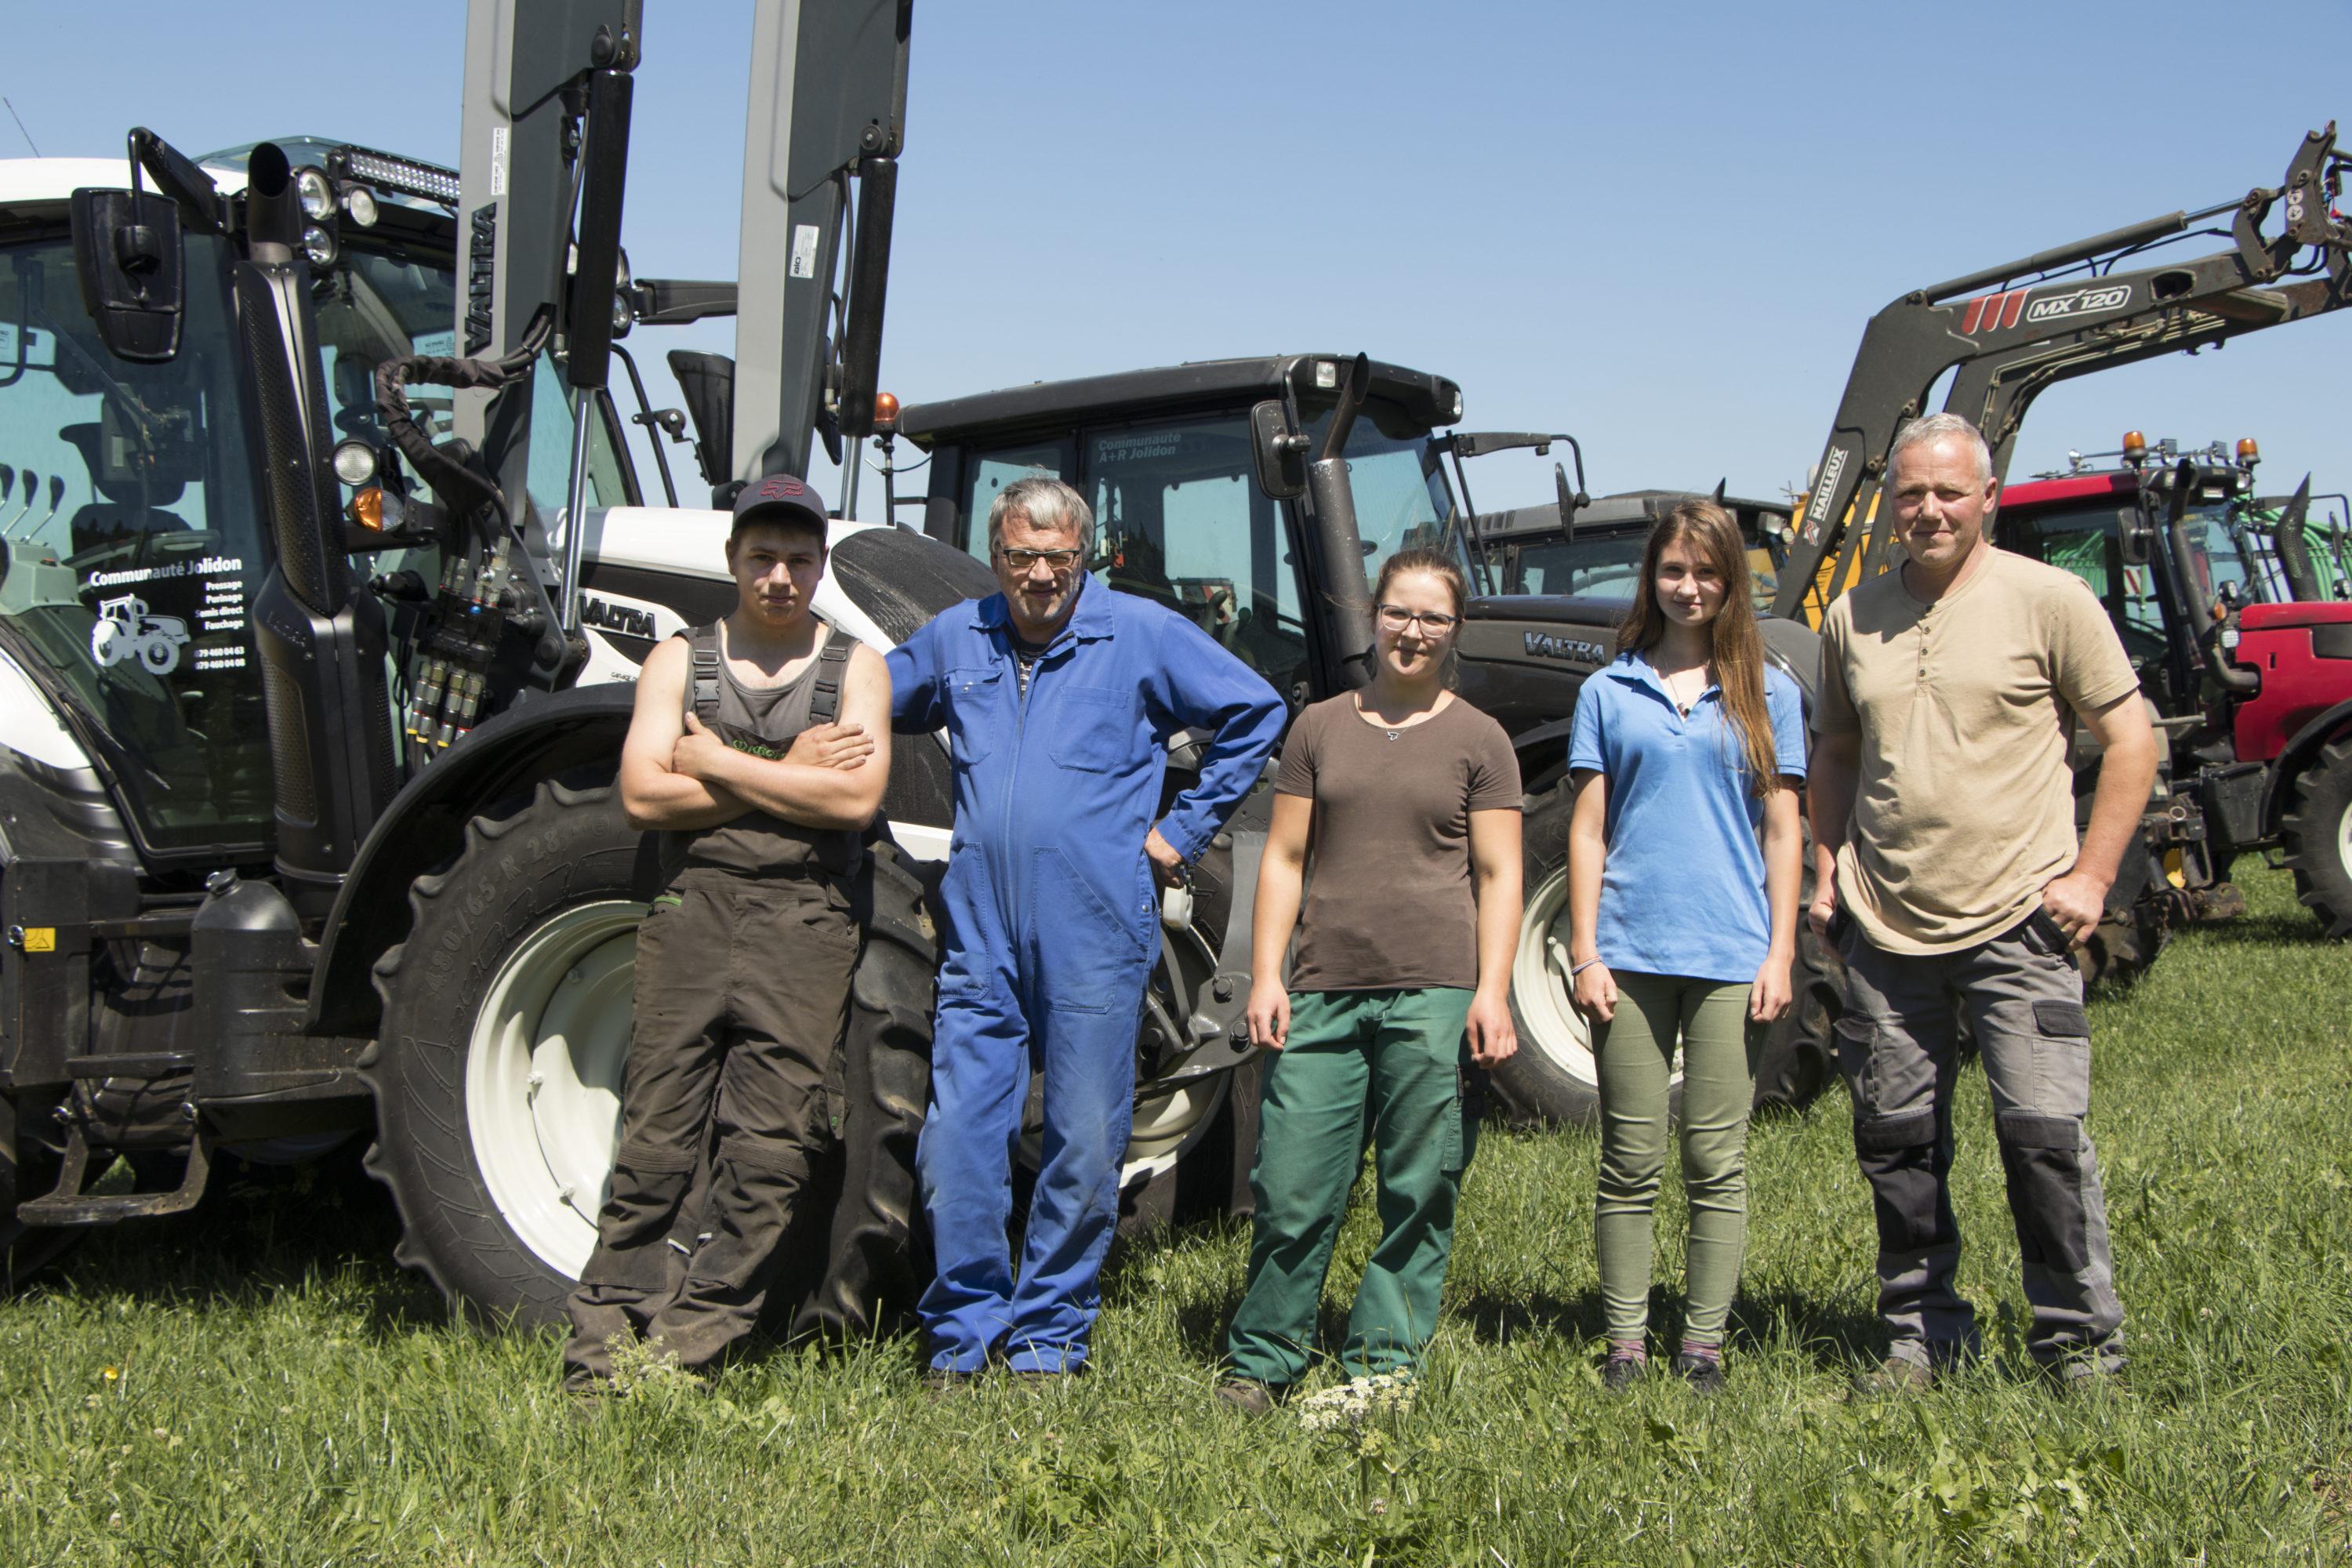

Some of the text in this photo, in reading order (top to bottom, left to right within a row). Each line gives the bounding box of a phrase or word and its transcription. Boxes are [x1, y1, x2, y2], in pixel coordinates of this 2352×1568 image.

[464, 201, 497, 357] VALTRA
[2032, 290, 2125, 318] MX 120
[1098, 445, 1176, 463] A+R Jolidon
[1812, 448, 1846, 520] MAILLEUX
[89, 556, 243, 586] Communauté Jolidon
[205, 581, 243, 591] Pressage
[205, 593, 243, 604] Purinage
[195, 606, 244, 618] Semis direct
[205, 619, 244, 630] Fauchage
[578, 594, 656, 640] VALTRA
[1523, 630, 1606, 666] VALTRA
[426, 827, 561, 991] 480/65 R 28
